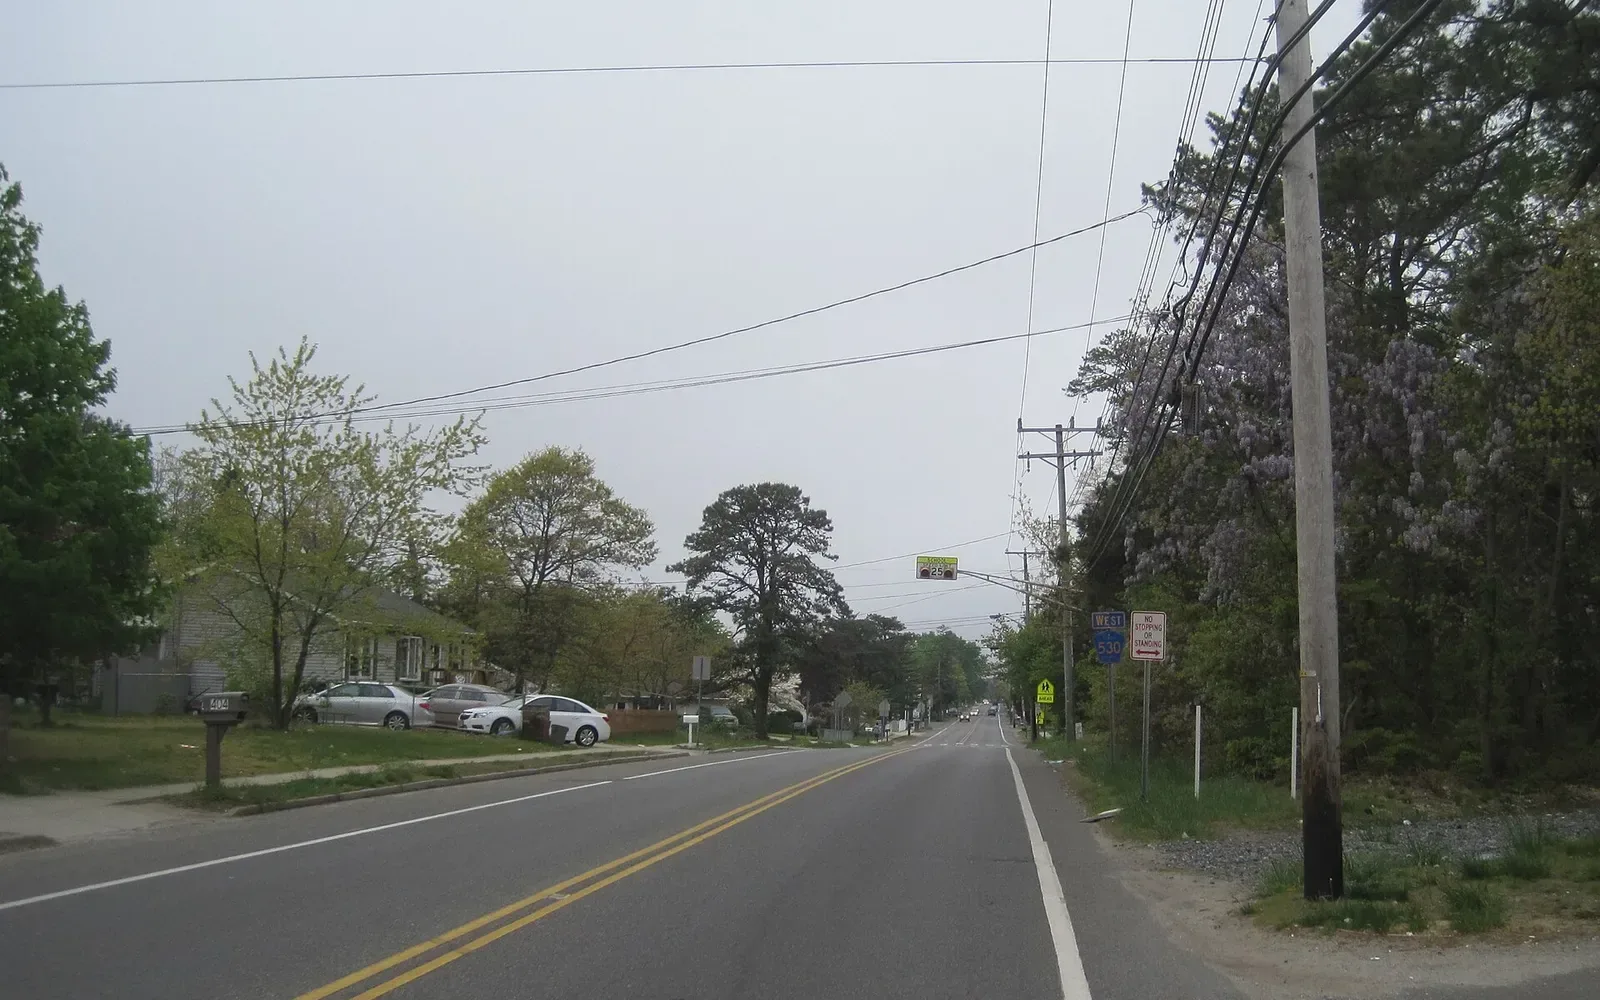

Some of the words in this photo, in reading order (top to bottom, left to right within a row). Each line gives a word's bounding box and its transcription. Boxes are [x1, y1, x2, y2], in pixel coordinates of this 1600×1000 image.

[931, 567, 943, 576] 25
[1095, 615, 1122, 626] WEST
[1144, 615, 1153, 623] NO
[1135, 623, 1162, 631] STOPPING
[1098, 641, 1121, 655] 530
[1135, 640, 1162, 648] STANDING
